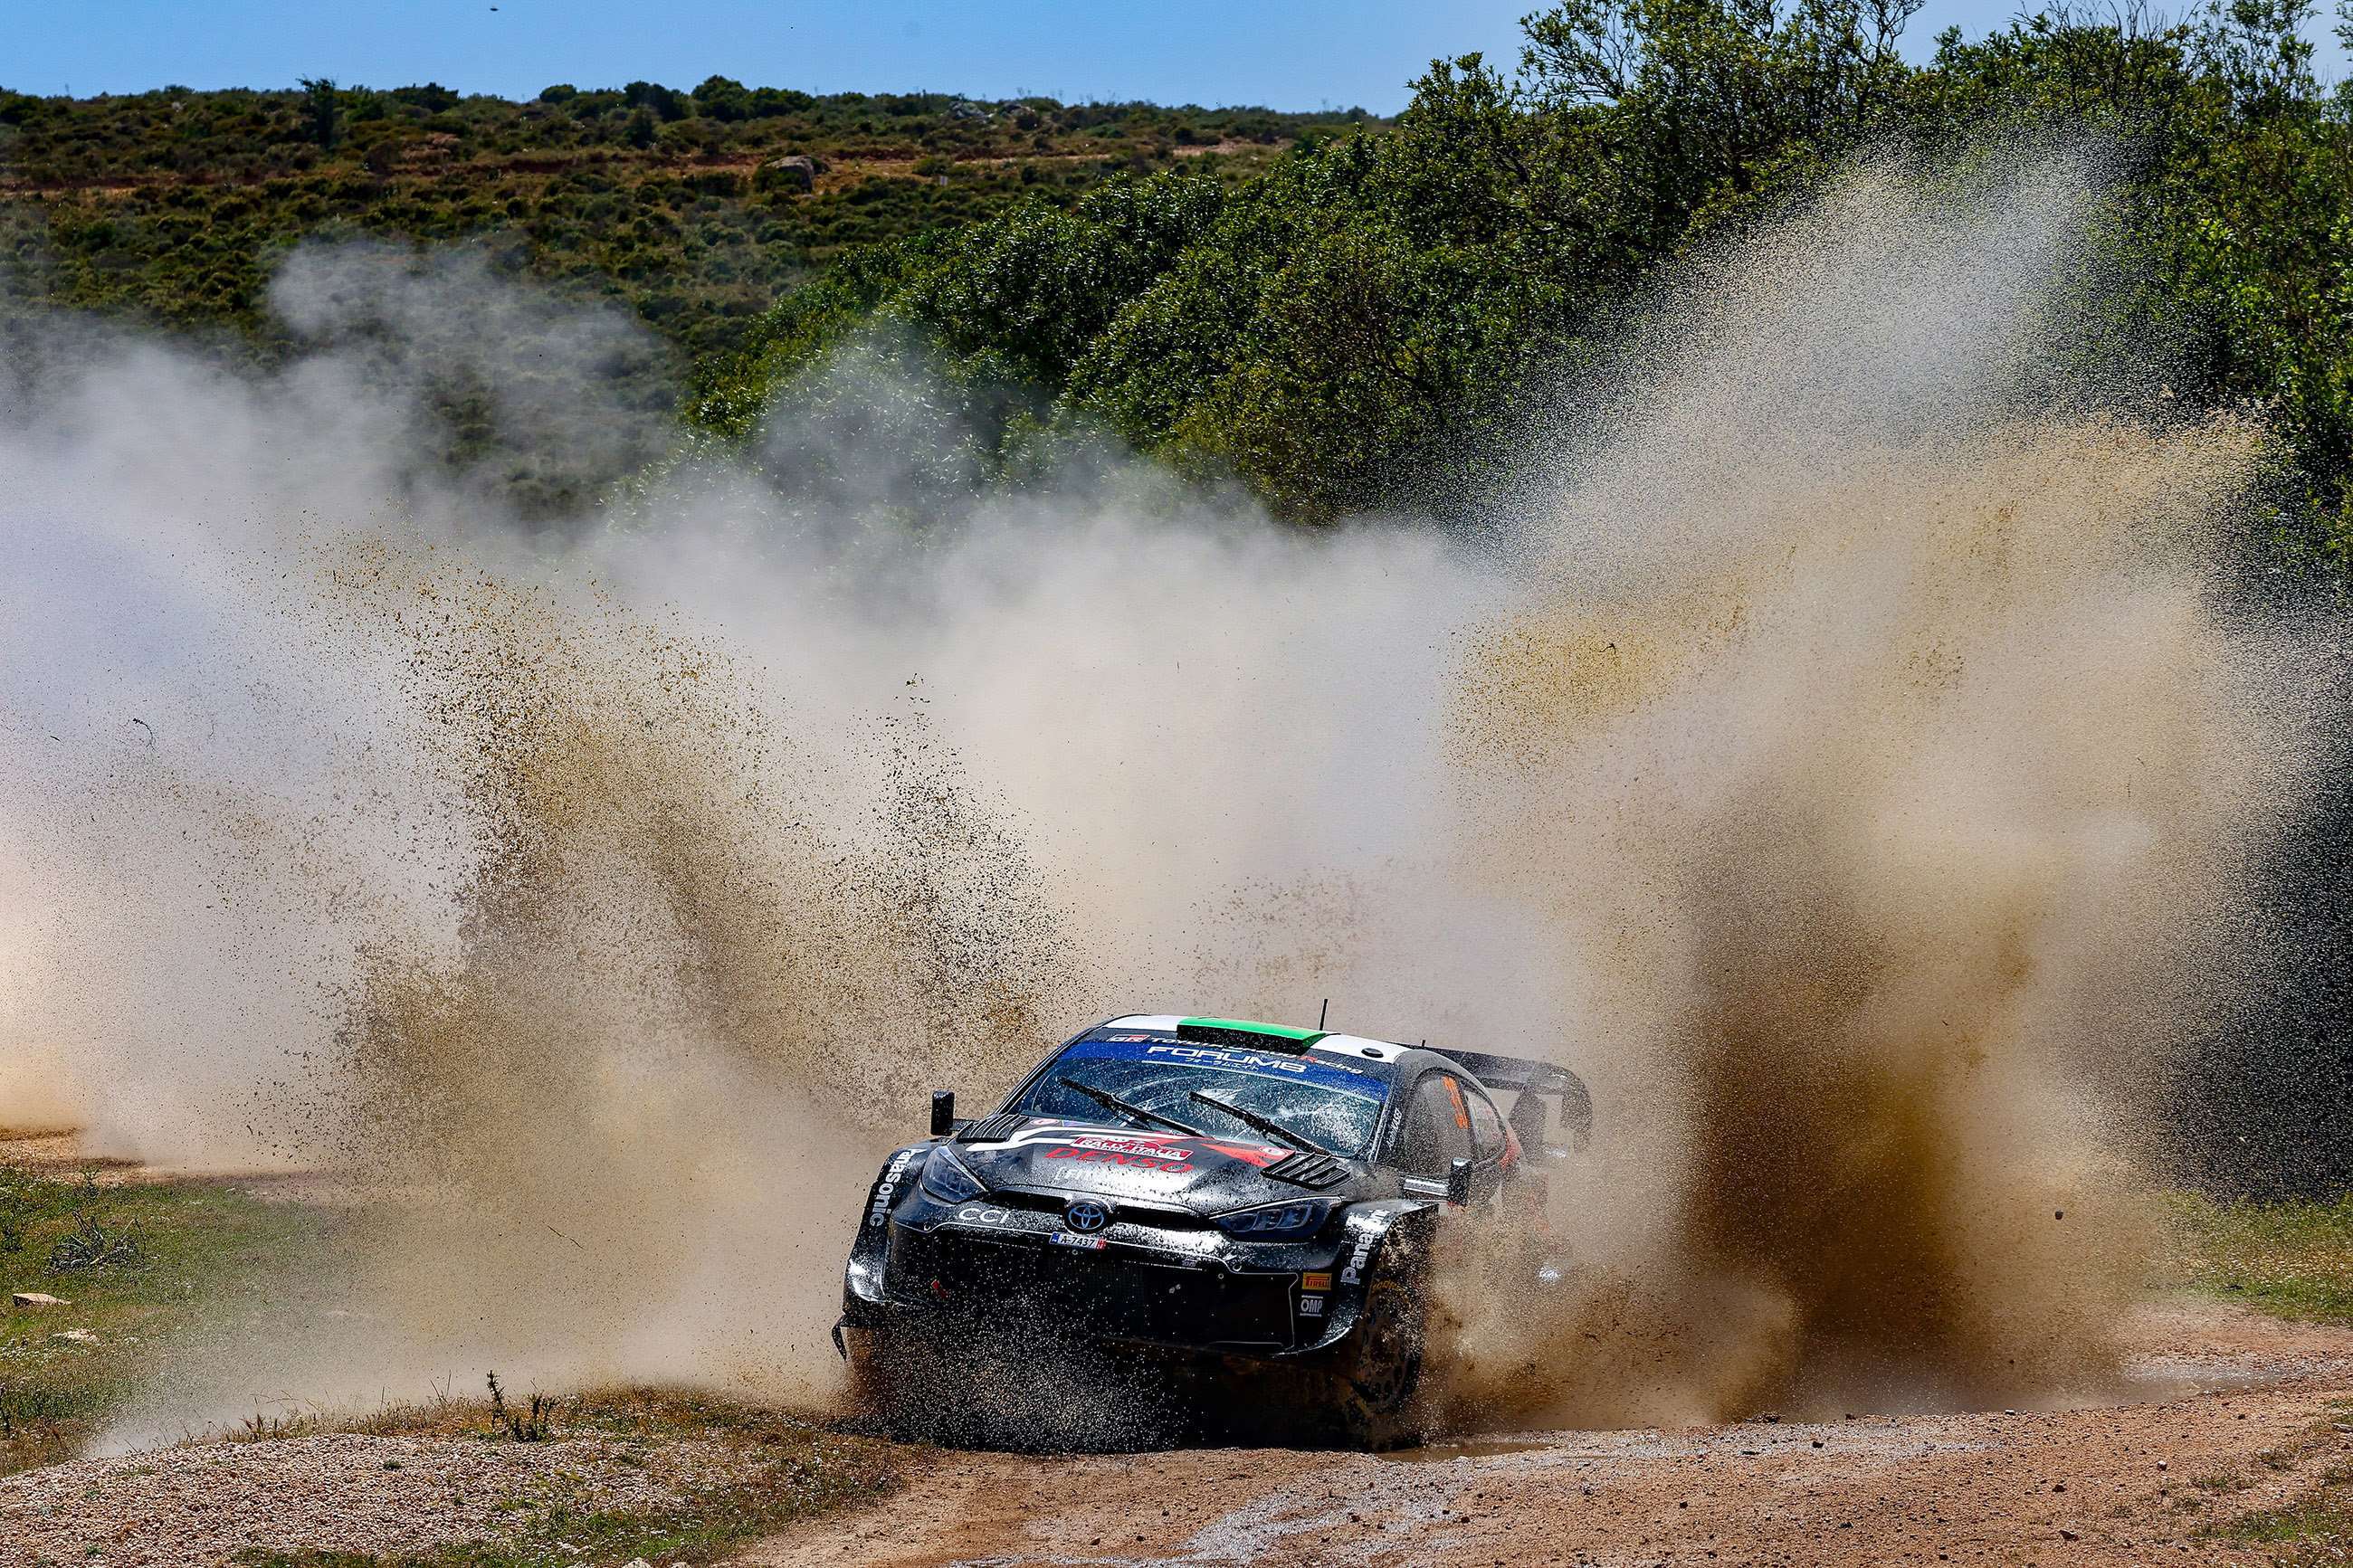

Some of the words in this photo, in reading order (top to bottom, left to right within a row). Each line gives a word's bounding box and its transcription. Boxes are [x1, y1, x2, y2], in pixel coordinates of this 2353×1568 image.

[1147, 1046, 1308, 1073] FORUM8
[1043, 1147, 1195, 1174] DENSO
[1300, 1298, 1323, 1313] OMP
